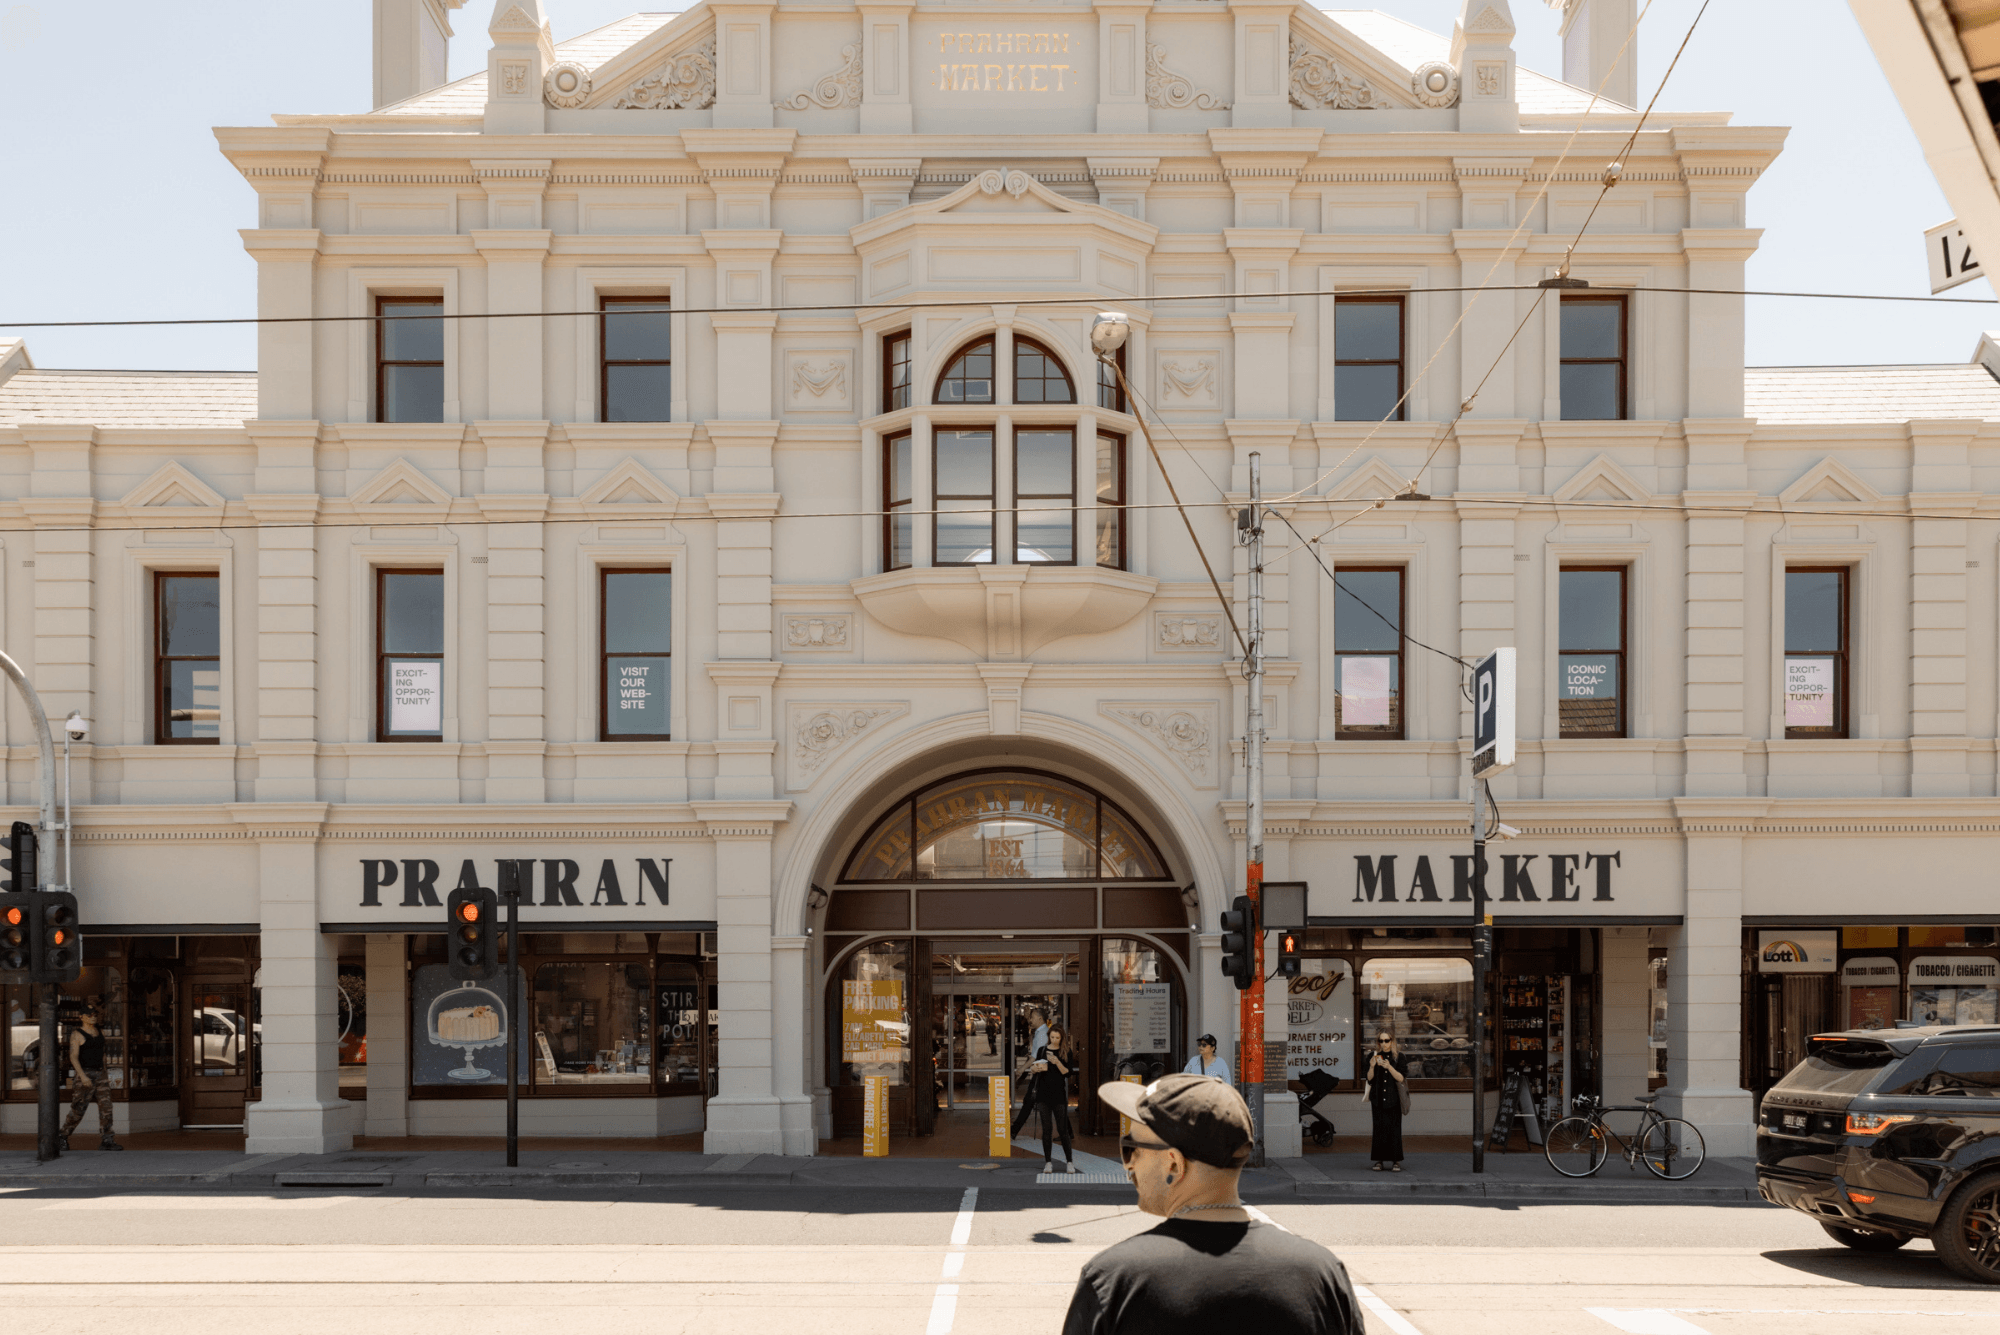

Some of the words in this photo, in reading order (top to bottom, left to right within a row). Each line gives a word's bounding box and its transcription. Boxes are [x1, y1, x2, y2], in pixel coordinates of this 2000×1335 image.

[940, 33, 1070, 54] PRAHRAN
[939, 64, 1070, 91] MARKET
[396, 669, 427, 677] EXCIT-
[620, 667, 649, 676] VISIT
[1567, 665, 1607, 674] ICONIC
[1789, 666, 1821, 674] EXCIT-
[620, 678, 645, 687] OUR
[1567, 676, 1604, 685] LOCA-
[1789, 675, 1806, 683] ING
[395, 688, 435, 696] OPPOR-
[1567, 686, 1594, 695] TION
[1789, 684, 1828, 692] OPPOR-
[620, 689, 651, 698] WEB-
[395, 697, 431, 705] TUNITY
[620, 700, 645, 709] SITE
[1478, 670, 1493, 739] P
[989, 840, 1024, 858] EST
[1352, 850, 1621, 902] MARKET
[359, 858, 673, 907] PRAHRAN
[1763, 950, 1793, 962] Lott
[1845, 967, 1867, 976] TOBACCO
[1871, 967, 1896, 975] CIGARETTE
[1916, 965, 1951, 977] TOBACCO
[1957, 965, 1996, 977] CIGARETTE
[844, 981, 874, 995] FREE
[1288, 970, 1346, 1001] eo's
[661, 992, 693, 1008] STIR
[844, 996, 900, 1010] PARKING
[1288, 1002, 1317, 1011] ARKET
[663, 1024, 692, 1040] POT
[844, 1032, 885, 1042] ELIZABETH
[1320, 1033, 1346, 1042] SHOP
[844, 1042, 860, 1051] CAR
[863, 1042, 884, 1051] PARK
[1305, 1046, 1322, 1054] THE
[844, 1052, 877, 1061] MARKET
[879, 1052, 900, 1061] DAYS
[1312, 1058, 1339, 1067] SHOP
[864, 1078, 875, 1128] PARK4FREE
[995, 1079, 1006, 1124] ELIZABETH
[995, 1127, 1006, 1139] ST
[864, 1132, 875, 1153] 7-11
